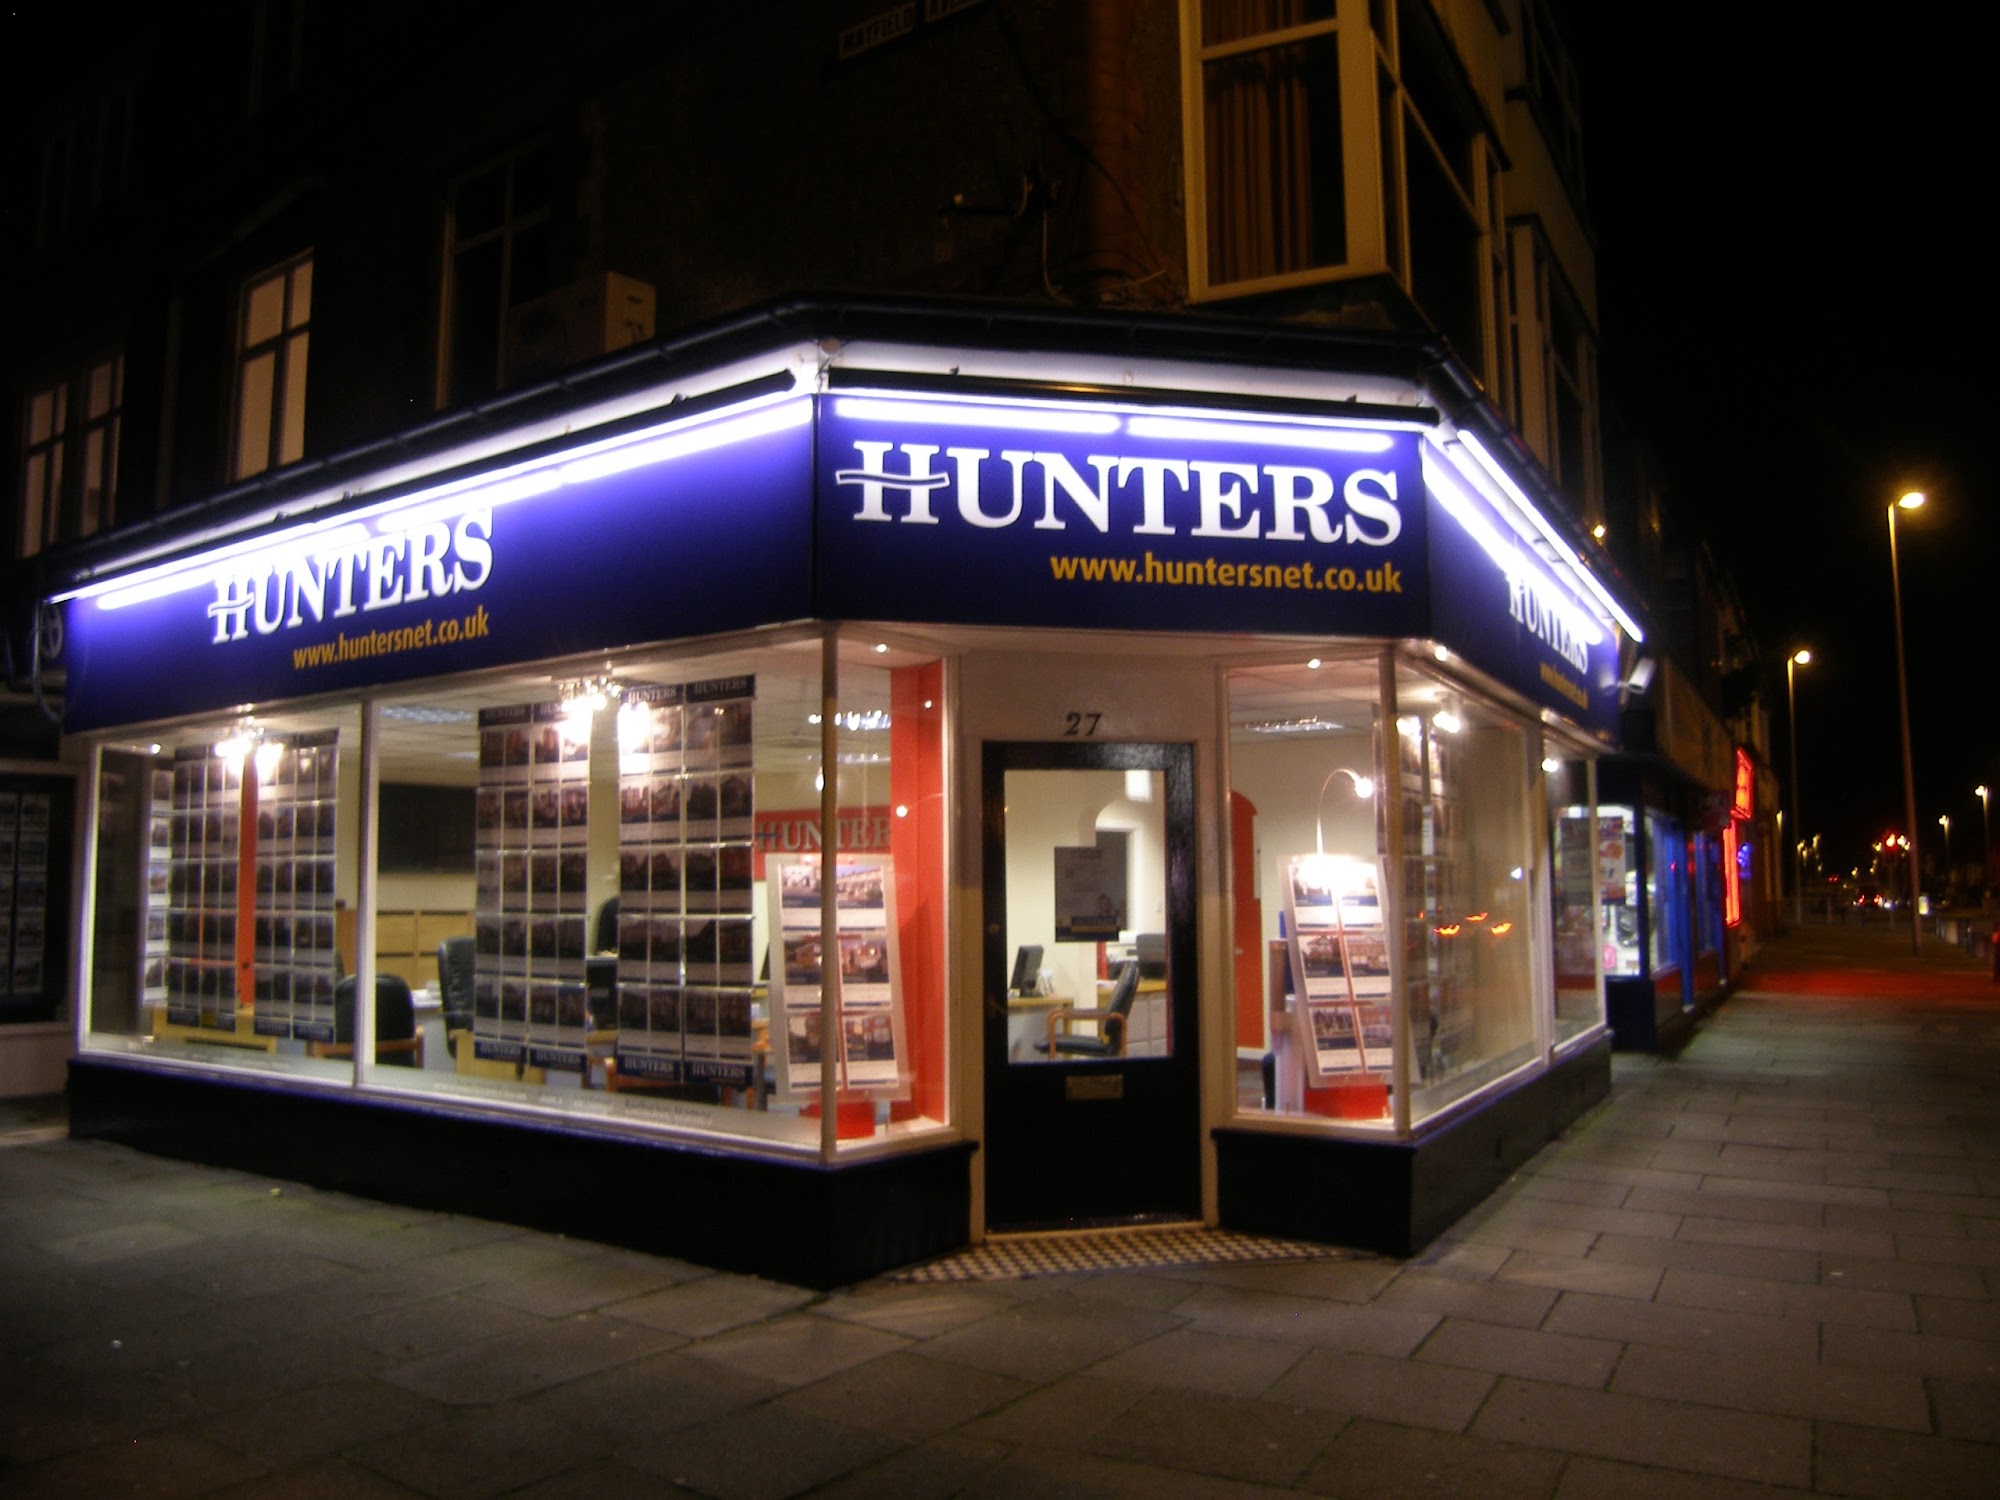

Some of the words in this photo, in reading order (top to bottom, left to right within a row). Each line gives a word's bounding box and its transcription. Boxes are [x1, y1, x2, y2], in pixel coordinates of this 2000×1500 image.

[836, 441, 1402, 547] HUNTERS
[207, 506, 494, 645] HUNTERS
[1050, 551, 1402, 594] www.huntersnet.co.uk
[292, 603, 491, 670] www.huntersnet.co.uk
[1064, 711, 1102, 736] 27
[624, 1058, 674, 1074] HUNTERS
[691, 1063, 747, 1079] HUNTERS
